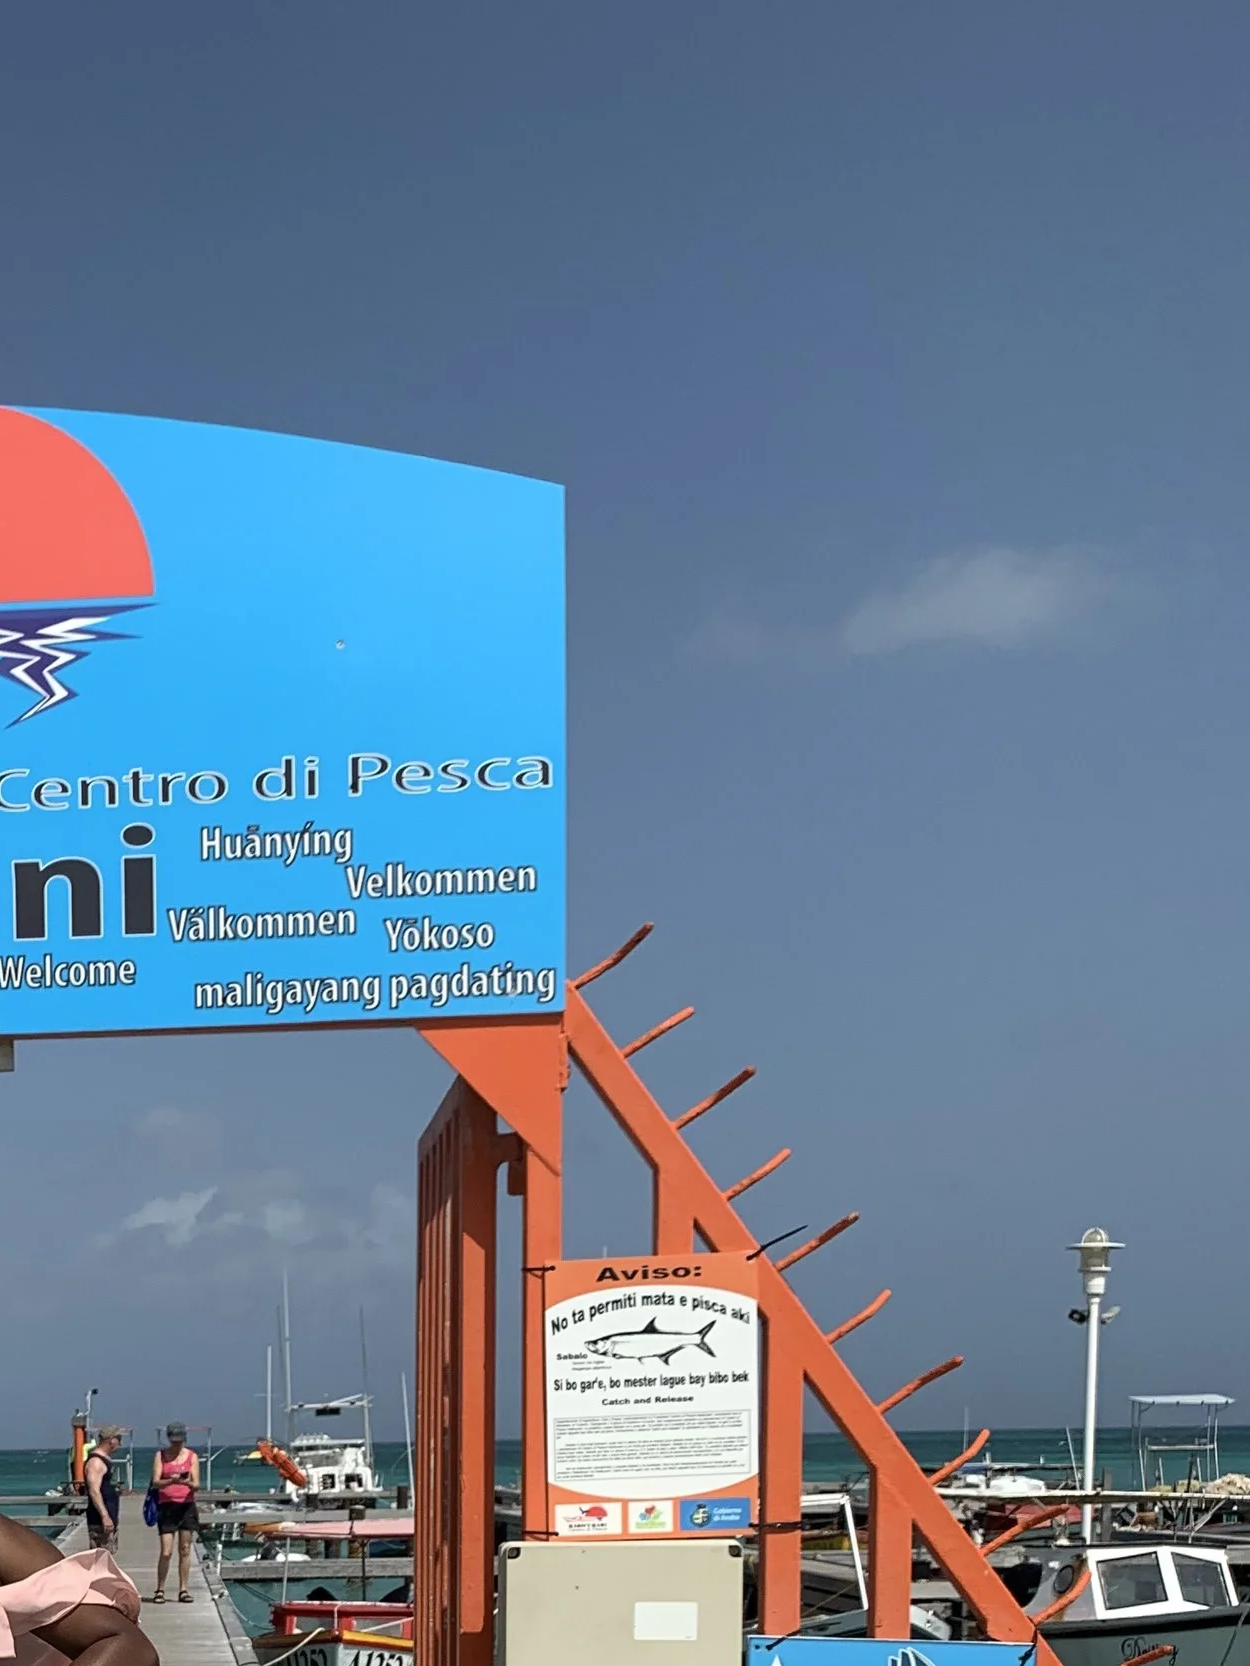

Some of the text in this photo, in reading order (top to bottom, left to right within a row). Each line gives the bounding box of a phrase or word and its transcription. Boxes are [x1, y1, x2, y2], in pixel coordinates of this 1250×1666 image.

[252, 755, 319, 801] di
[348, 753, 554, 796] Pesca
[345, 862, 537, 899] Velkommen
[167, 906, 356, 942] Välkommen
[384, 916, 495, 953] Yōkoso
[195, 961, 557, 1014] maligayang pagdating
[596, 1266, 702, 1282] Aviso:
[551, 1316, 568, 1335] No
[572, 1309, 585, 1324] ta
[589, 1293, 637, 1322] permiti
[641, 1292, 675, 1306] mata
[679, 1297, 687, 1306] e
[691, 1296, 727, 1315] pisca
[553, 1379, 563, 1391] Si
[566, 1379, 577, 1391] bo
[609, 1376, 621, 1389] bo
[624, 1374, 657, 1387] mester
[660, 1372, 686, 1388] lague
[689, 1371, 706, 1387] bay
[709, 1371, 728, 1384] bibo
[602, 1395, 694, 1406] Catch and Release
